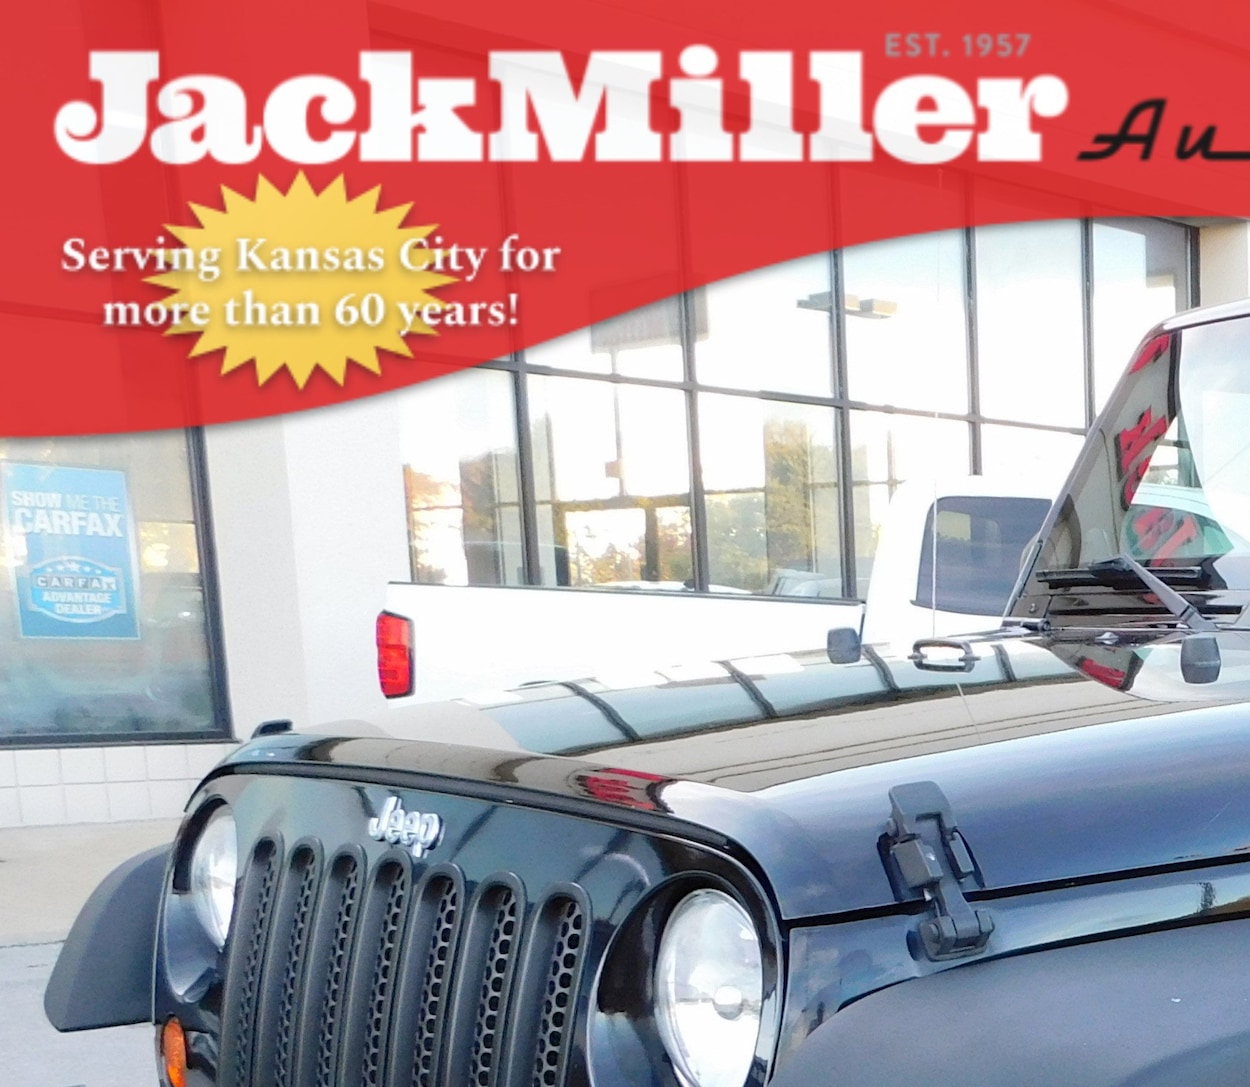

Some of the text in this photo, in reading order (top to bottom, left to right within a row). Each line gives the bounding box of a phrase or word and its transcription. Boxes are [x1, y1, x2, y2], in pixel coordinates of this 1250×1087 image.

[12, 490, 120, 513] SHOW ME THE
[14, 507, 124, 537] CARFAX
[37, 575, 117, 591] CARFAX
[43, 591, 112, 604] ADVANTAGE
[55, 603, 102, 616] DEALER
[368, 795, 446, 858] Jeep
